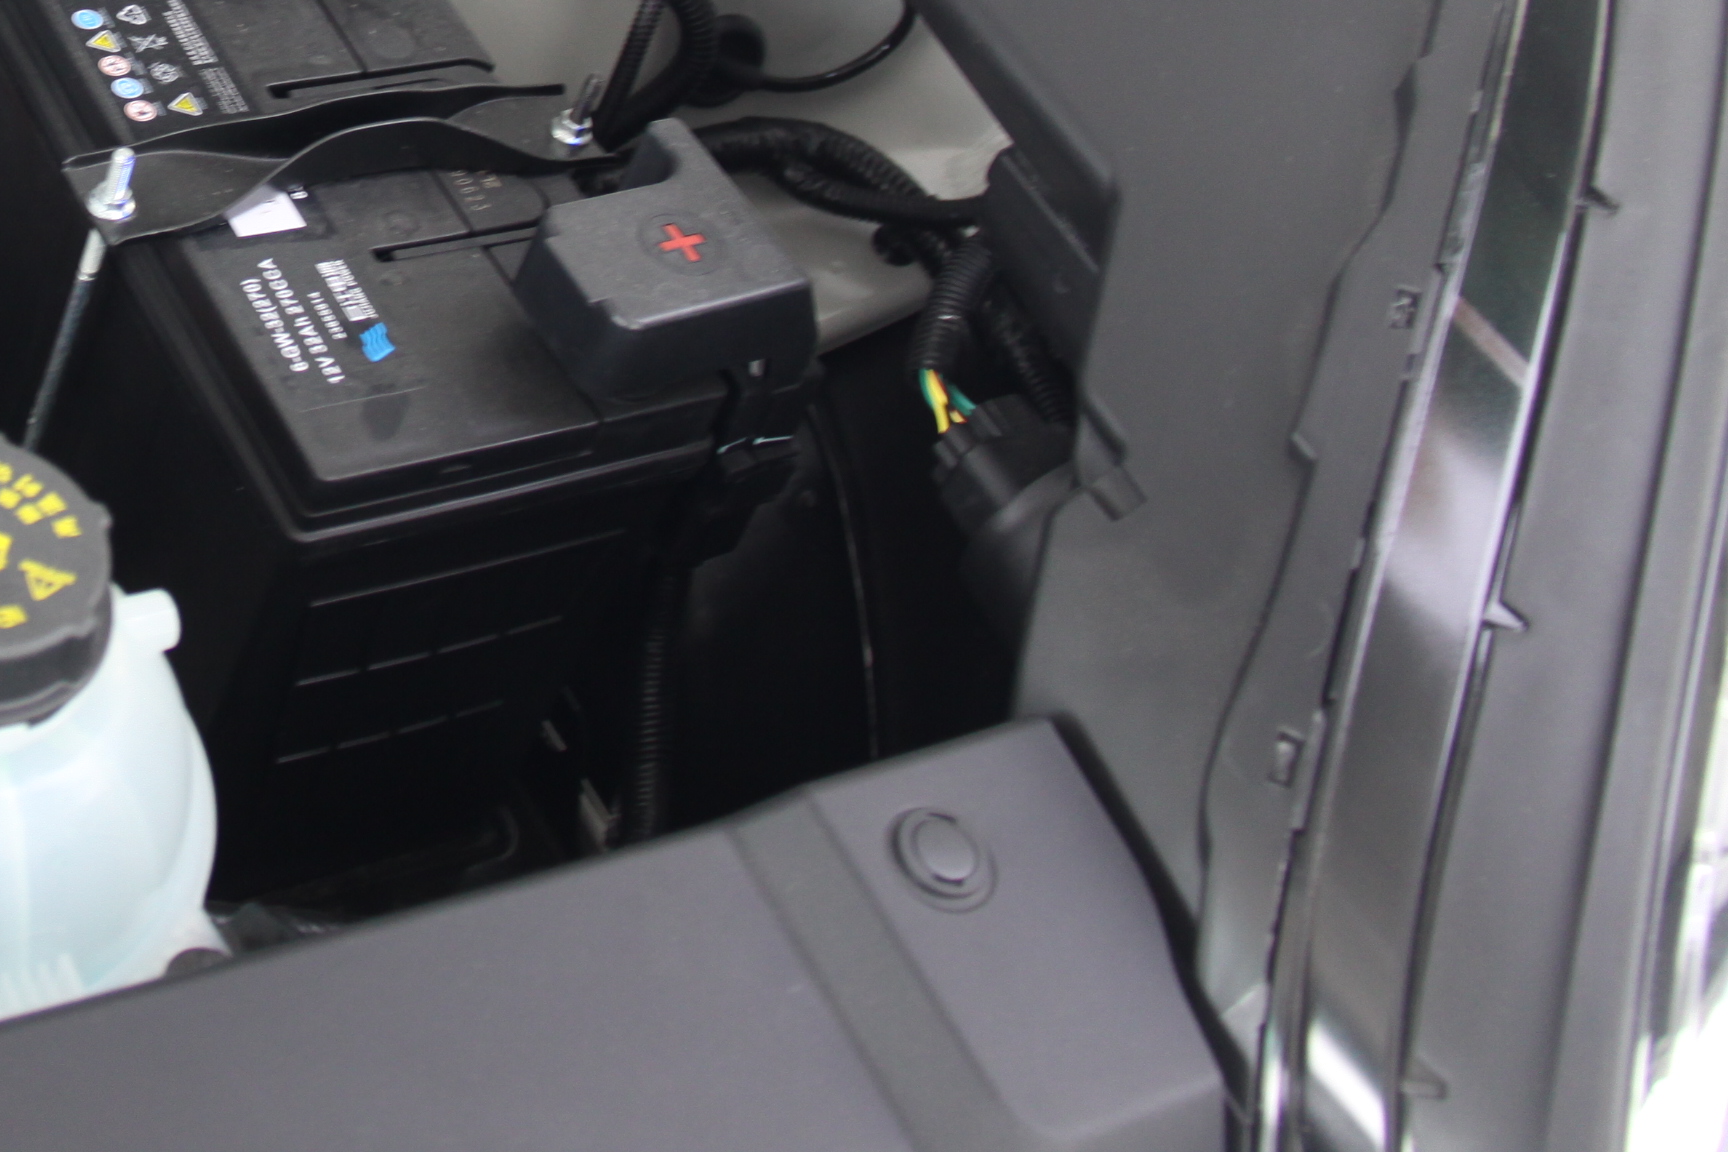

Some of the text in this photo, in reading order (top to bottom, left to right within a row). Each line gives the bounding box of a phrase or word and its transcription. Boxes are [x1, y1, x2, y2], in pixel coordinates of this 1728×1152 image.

[240, 278, 309, 372] 6-QW-32(270)
[257, 258, 346, 384] 12V 32Ah 270CCA
